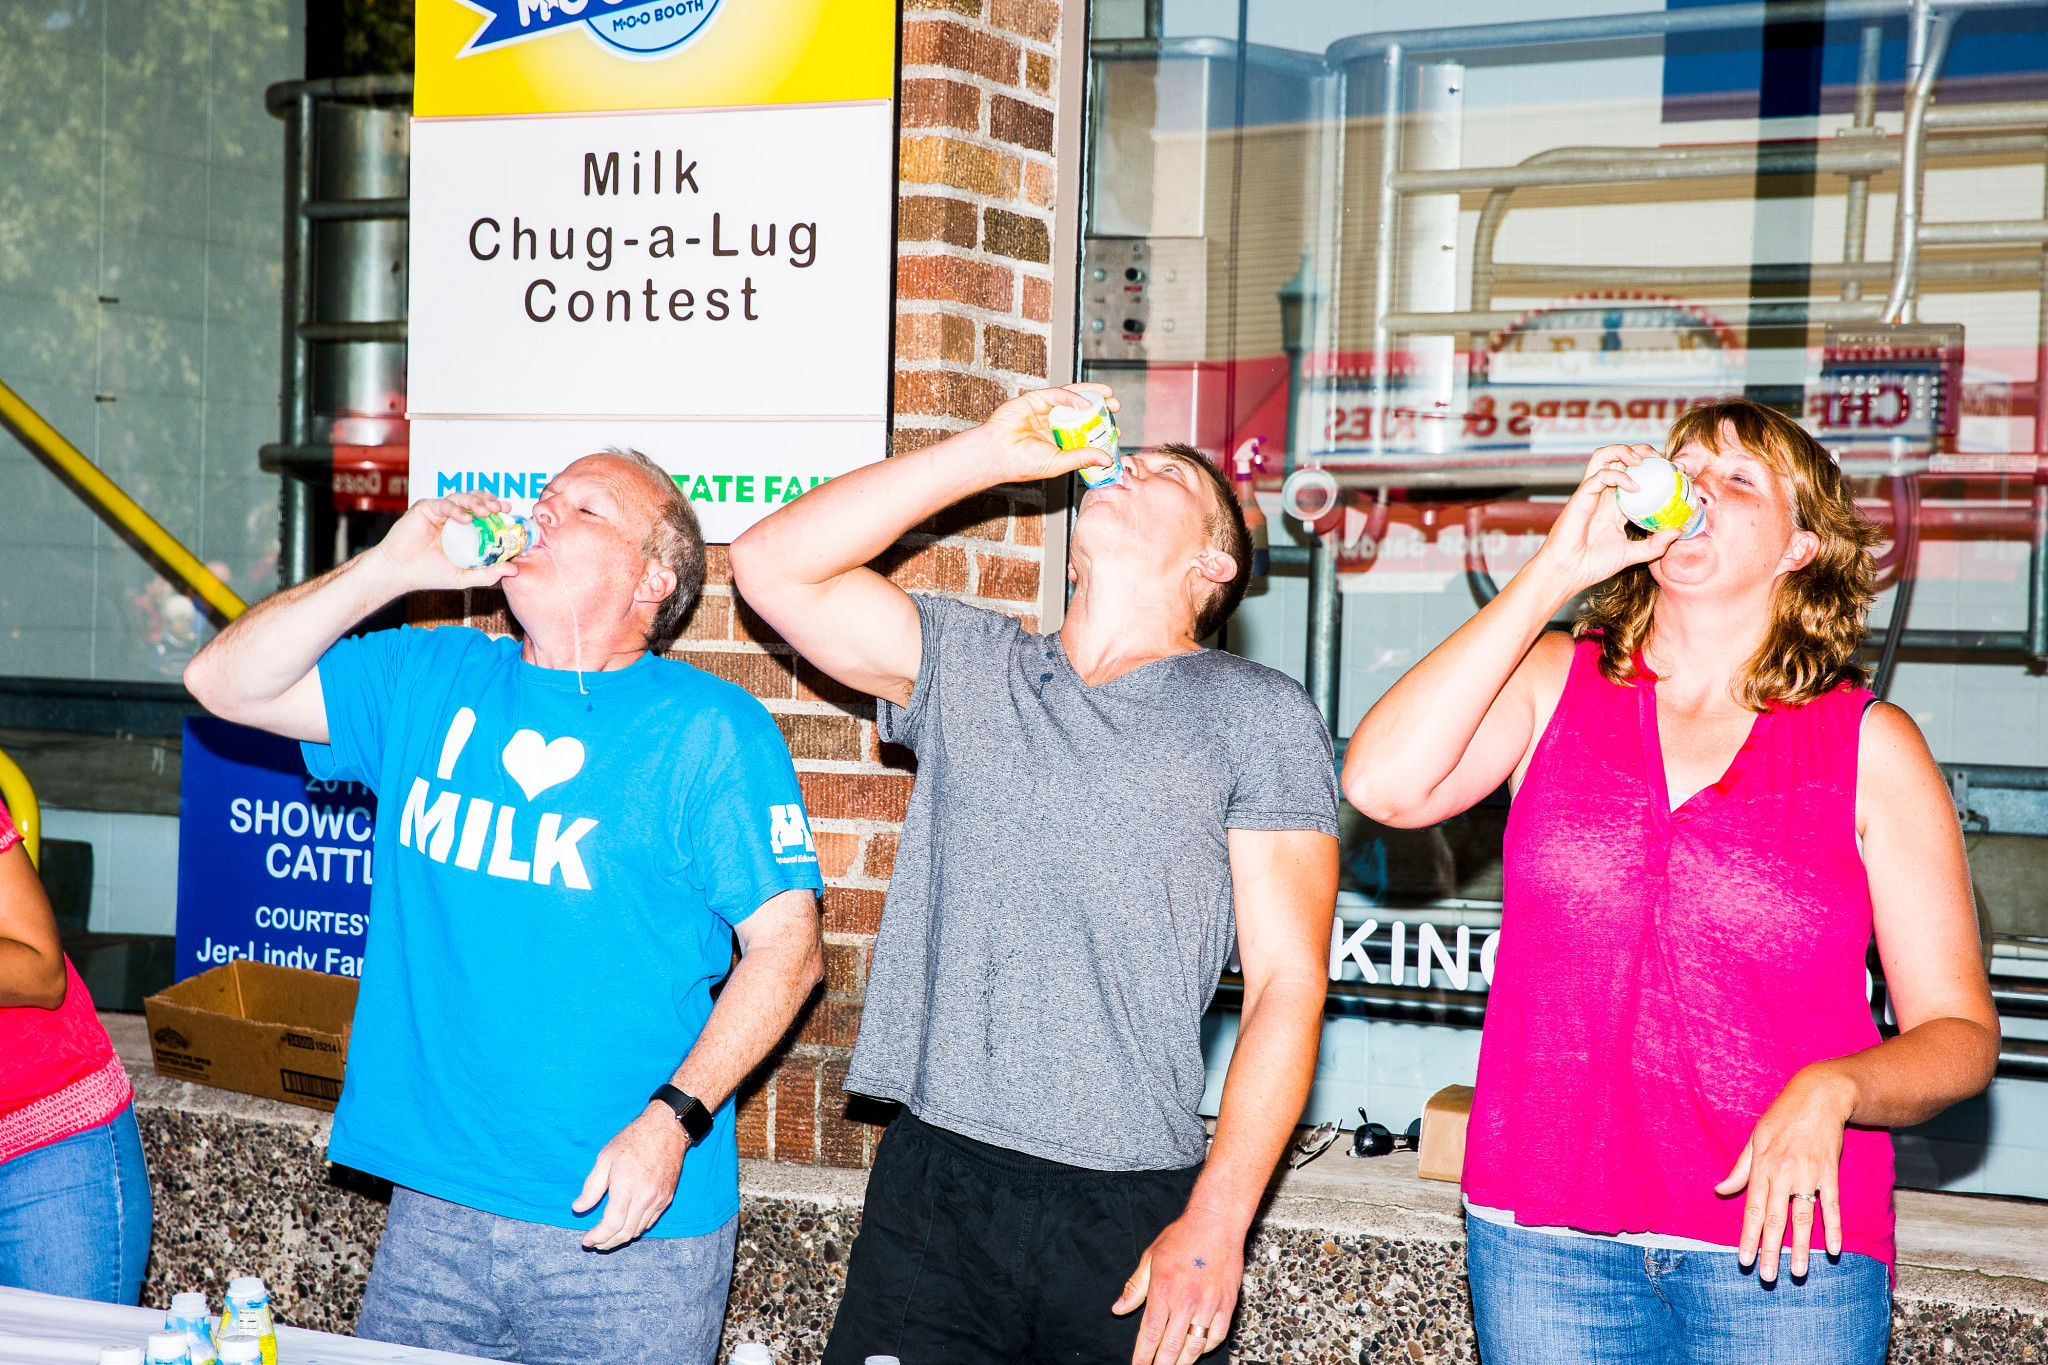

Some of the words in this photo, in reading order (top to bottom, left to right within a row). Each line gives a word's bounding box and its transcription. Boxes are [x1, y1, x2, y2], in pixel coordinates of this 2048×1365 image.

[654, 0, 704, 22] BOOTH
[584, 150, 699, 196] Milk
[469, 212, 817, 271] Chug-a-Lug
[524, 277, 759, 322] Contest
[437, 471, 560, 499] MINNE
[436, 706, 477, 780] I
[230, 798, 376, 842] SHOWC
[400, 776, 600, 890] MILK
